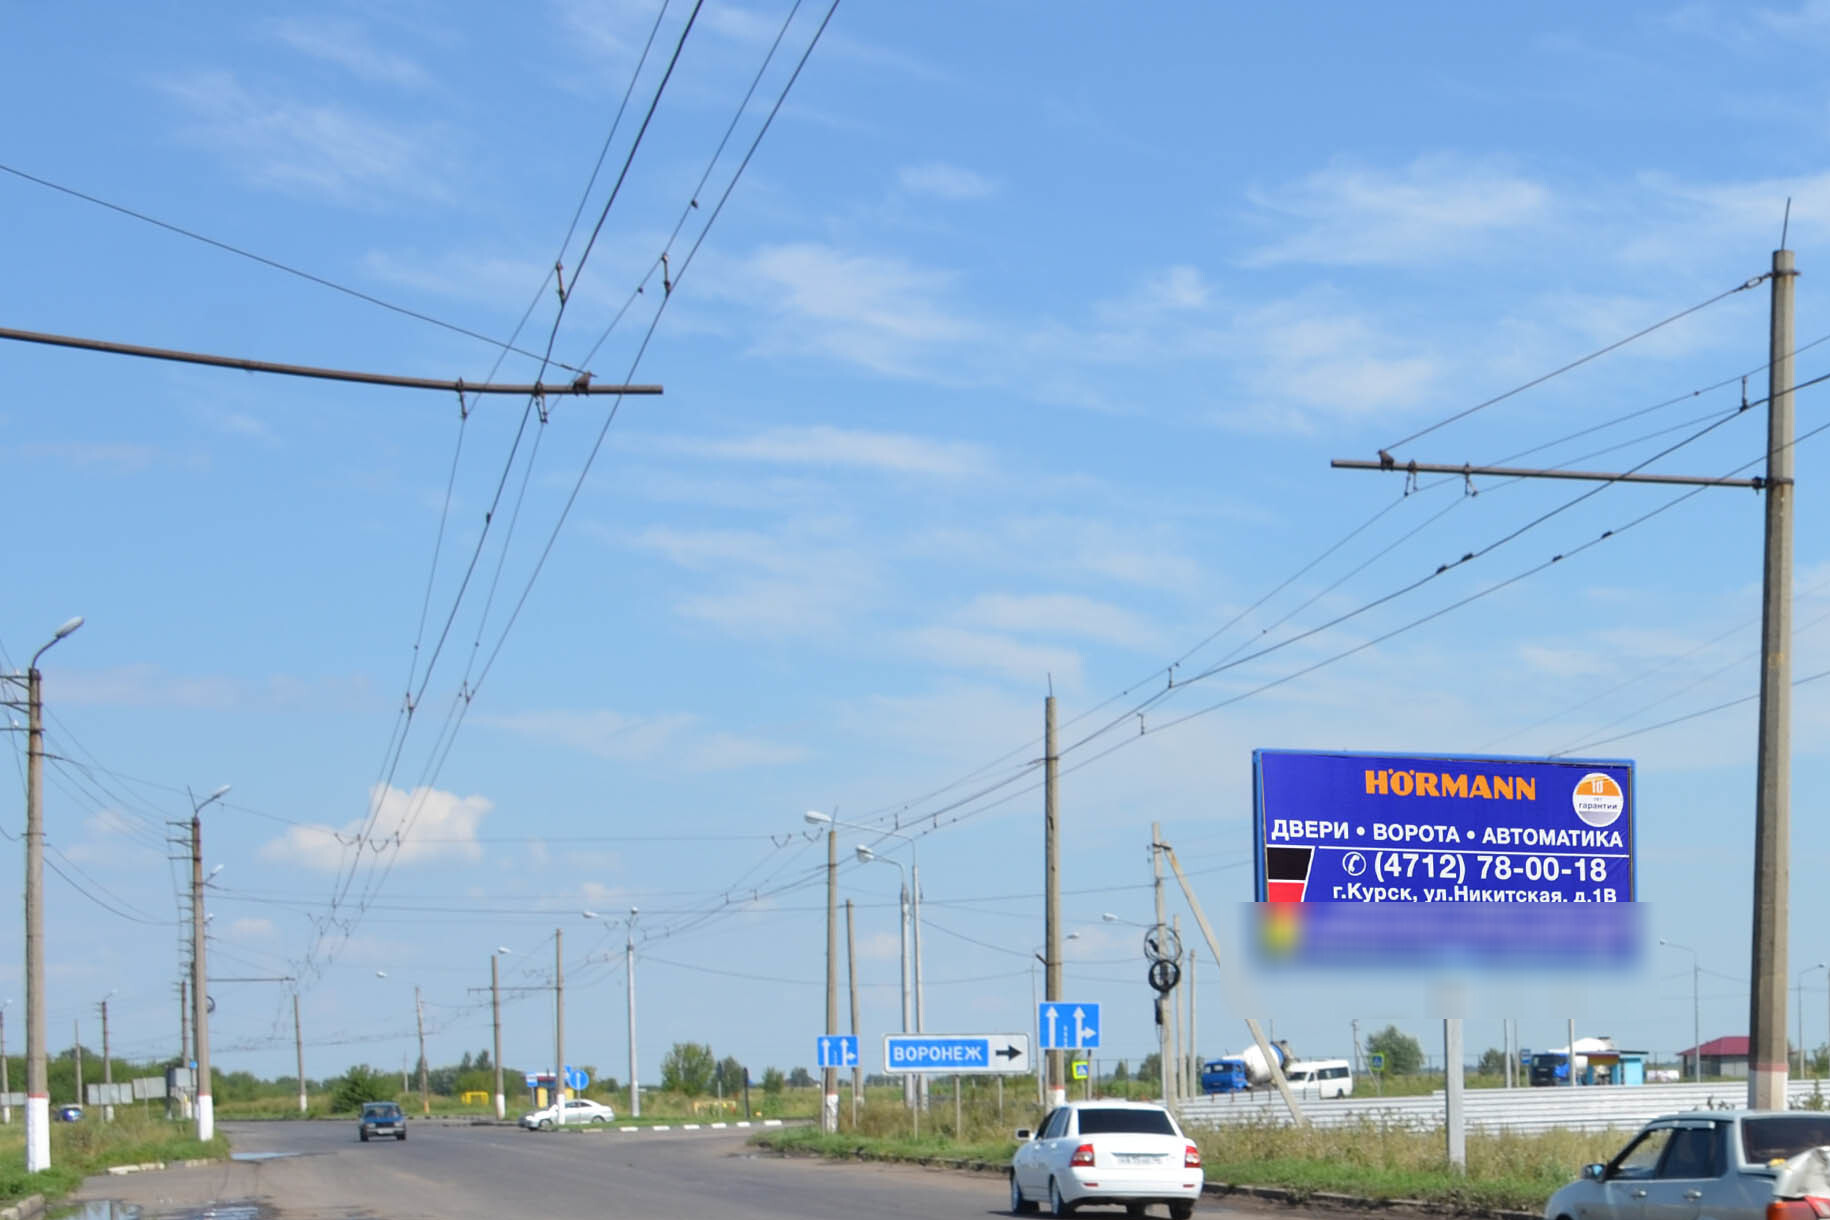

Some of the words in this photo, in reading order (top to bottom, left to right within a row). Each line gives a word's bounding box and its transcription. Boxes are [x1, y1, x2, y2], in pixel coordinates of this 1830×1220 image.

[1365, 768, 1536, 801] HÖRMANN
[1271, 819, 1349, 841] ДВЕРИ
[1373, 823, 1461, 843] ВОРОТА
[1482, 827, 1623, 848] АВТОМАТИКА
[1374, 851, 1466, 885] (4712)
[1477, 855, 1607, 882] 78-00-18
[1333, 882, 1418, 902] г.Курск,
[893, 1045, 983, 1062] ВОРОНЕЖ
